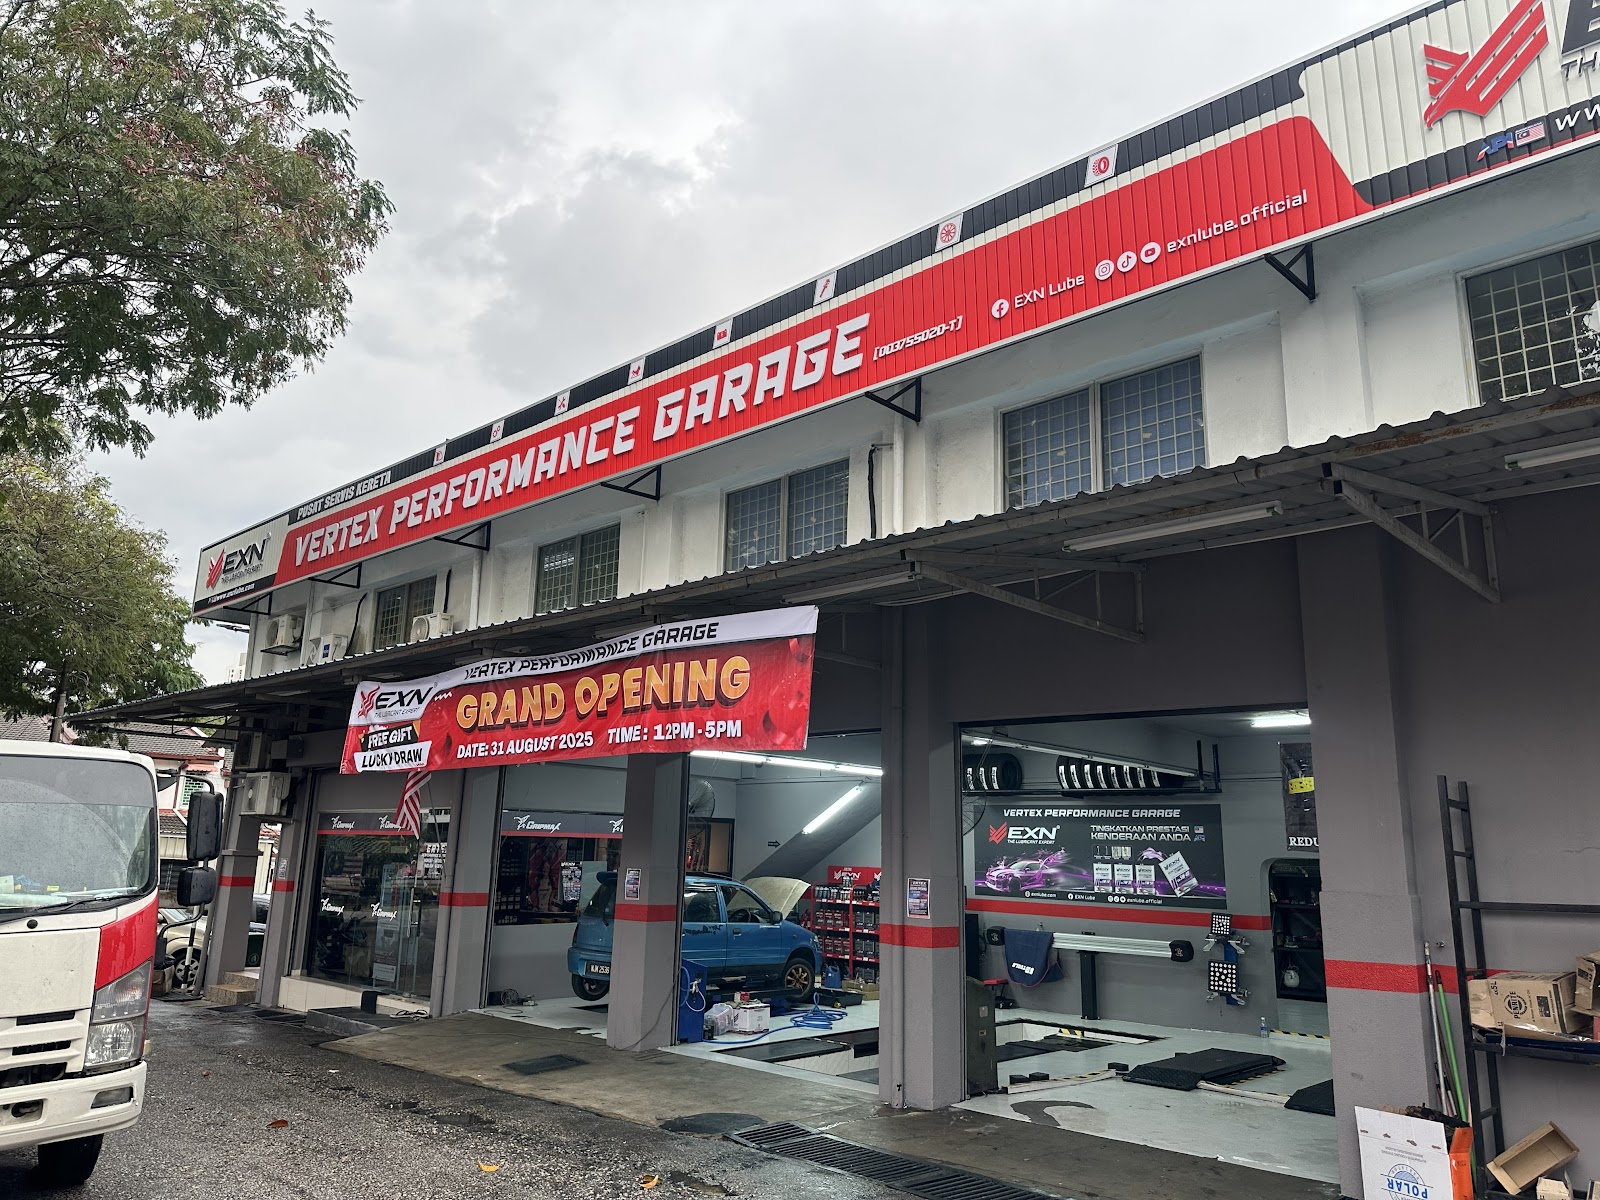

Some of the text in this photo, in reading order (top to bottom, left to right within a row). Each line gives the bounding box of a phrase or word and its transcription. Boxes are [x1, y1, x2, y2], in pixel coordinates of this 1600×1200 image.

[1167, 189, 1308, 253] exnlube.official
[1014, 274, 1085, 309] EXN Lube
[295, 312, 871, 567] VERTEX PERFORMANCE GARAGE
[297, 470, 392, 520] PUSAT SERVIS KERETA
[223, 539, 267, 574] EXN
[465, 622, 719, 680] VERTEX PERFORMANCE GARAGE
[375, 687, 433, 710] EXN
[456, 656, 750, 732] GRAND OPENING
[367, 726, 412, 749] FREE GIFT
[456, 742, 489, 759] DATE:
[491, 740, 504, 756] 31
[506, 736, 559, 755] AUGUST
[559, 731, 594, 749] 2025
[653, 722, 694, 740] 12PM
[704, 720, 742, 738] 5PM
[393, 748, 422, 765] DRAW
[1003, 809, 1180, 818] VERTEX PERFORMANCE GARAGE
[1007, 826, 1057, 840] EXN
[1091, 833, 1156, 841] KENDERAAN
[1158, 833, 1191, 841] ANDA
[1510, 991, 1520, 1019] PENRITE
[1387, 1178, 1428, 1199] POLAR
